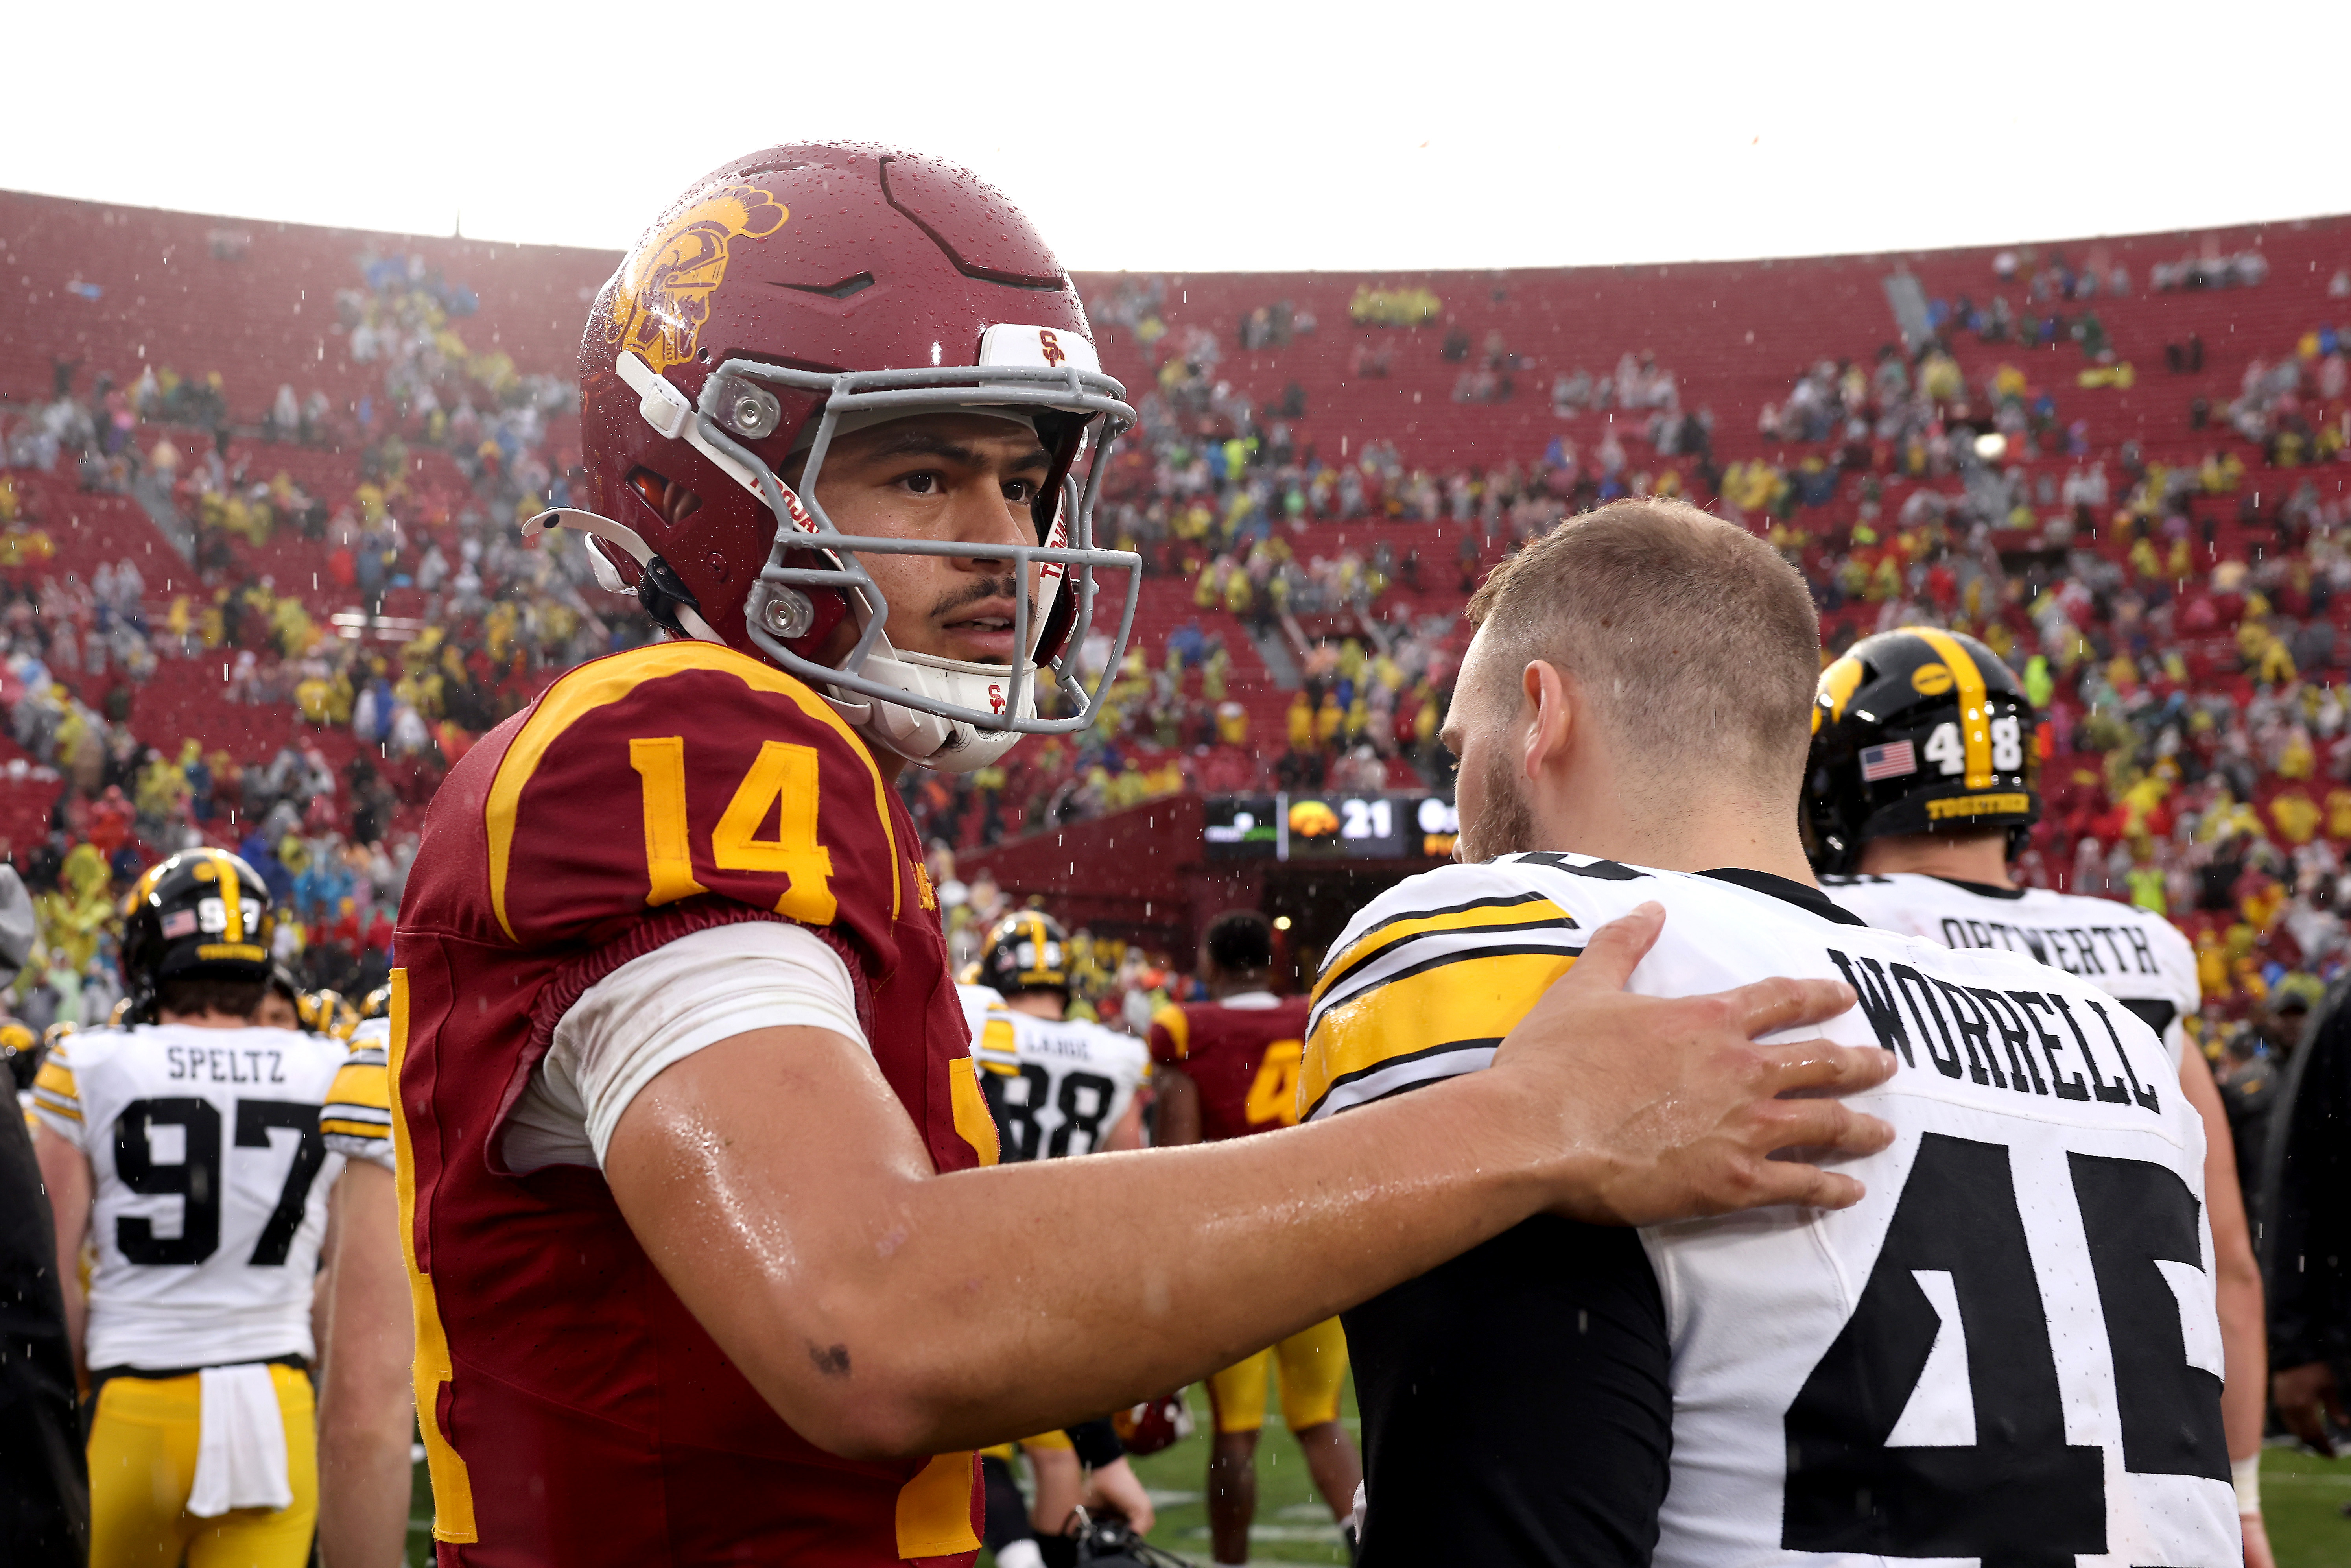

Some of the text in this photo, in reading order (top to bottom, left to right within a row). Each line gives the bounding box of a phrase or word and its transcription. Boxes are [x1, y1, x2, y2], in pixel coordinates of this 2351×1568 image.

[1924, 717, 2022, 776] 48
[630, 736, 837, 925] 14
[1342, 799, 1392, 839] 21
[168, 1046, 286, 1084] SPELTZ
[1827, 949, 2160, 1114] WORRELL
[115, 1097, 326, 1265] 97
